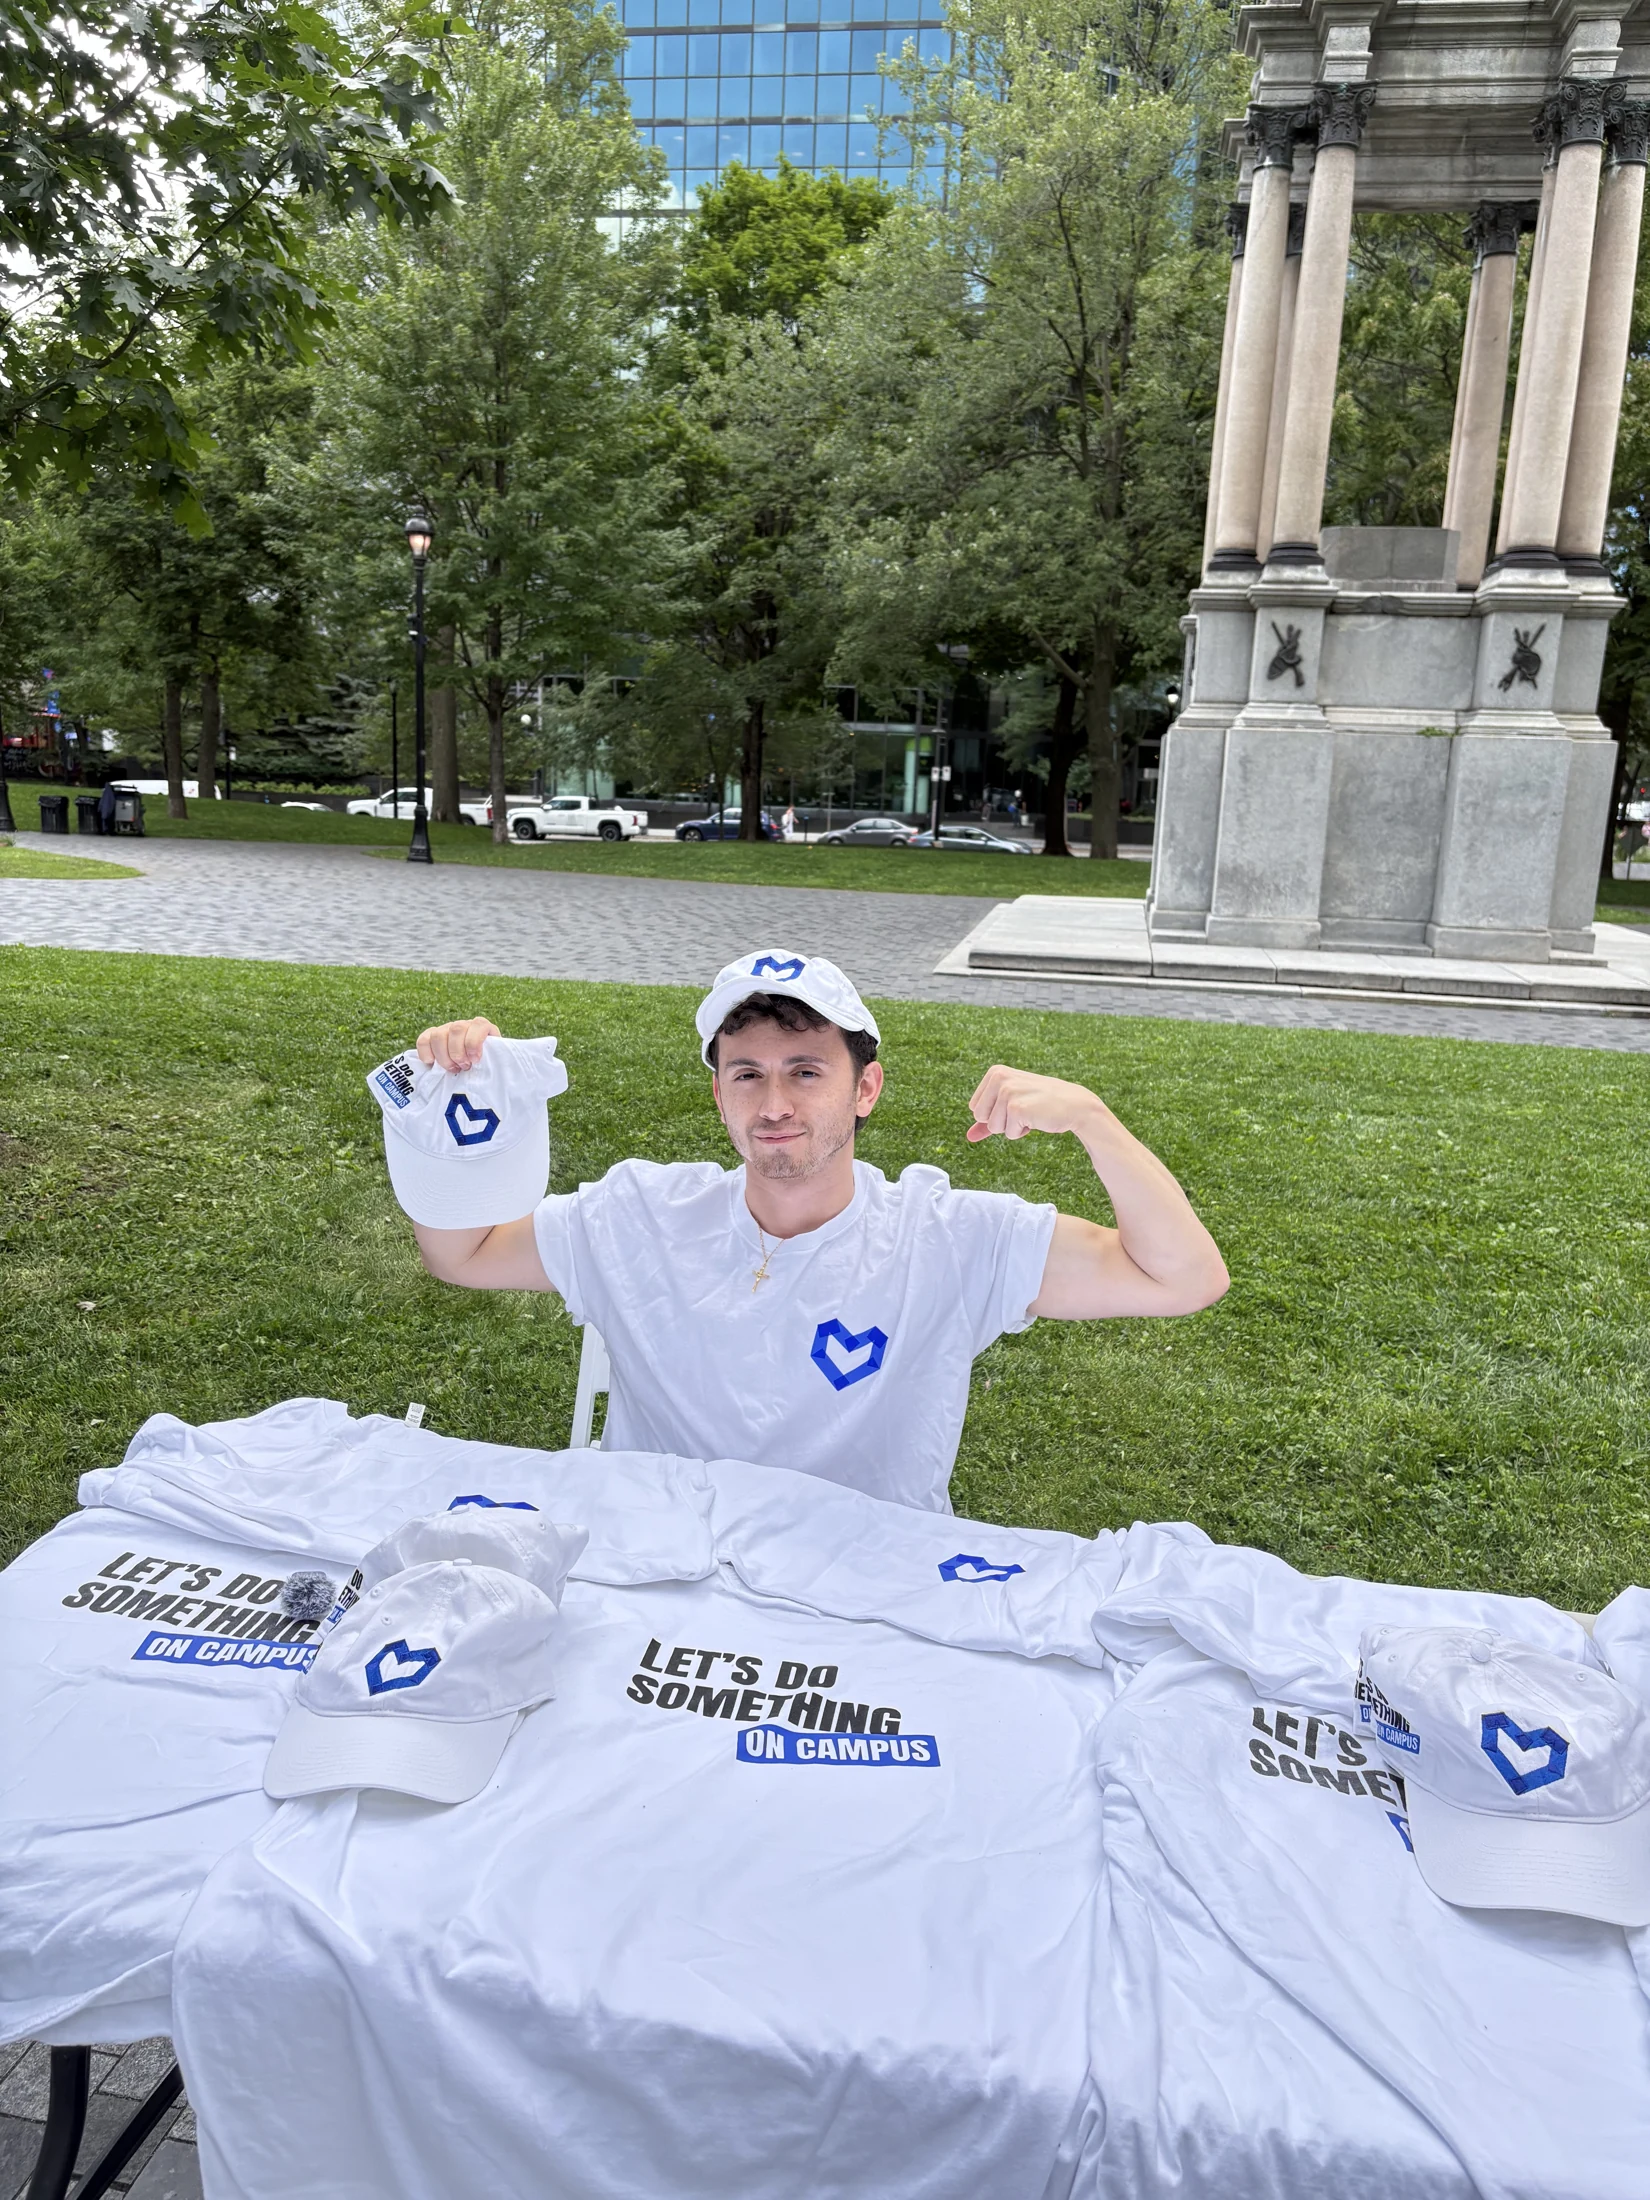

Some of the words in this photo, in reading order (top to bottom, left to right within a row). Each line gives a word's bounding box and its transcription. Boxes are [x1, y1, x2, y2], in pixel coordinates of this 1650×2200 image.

[384, 1060, 414, 1096] ETHING
[399, 1063, 414, 1077] DO
[378, 1073, 389, 1085] ON
[384, 1081, 408, 1107] CAMPUS
[97, 1551, 222, 1592] LET'S
[216, 1573, 286, 1605] DO
[62, 1581, 322, 1644] SOMETHING
[145, 1637, 192, 1660] ON
[201, 1640, 317, 1668] CAMPUS
[639, 1637, 763, 1686] LET'S
[775, 1660, 839, 1690] DO
[626, 1673, 902, 1736] SOMETHING
[1371, 1697, 1410, 1734] ETHING
[745, 1729, 785, 1760] ON
[796, 1738, 932, 1763] CAMPUS
[1252, 1706, 1367, 1767] LET'S
[1386, 1727, 1418, 1751] CAMPUS
[1248, 1738, 1408, 1813] SOMET
